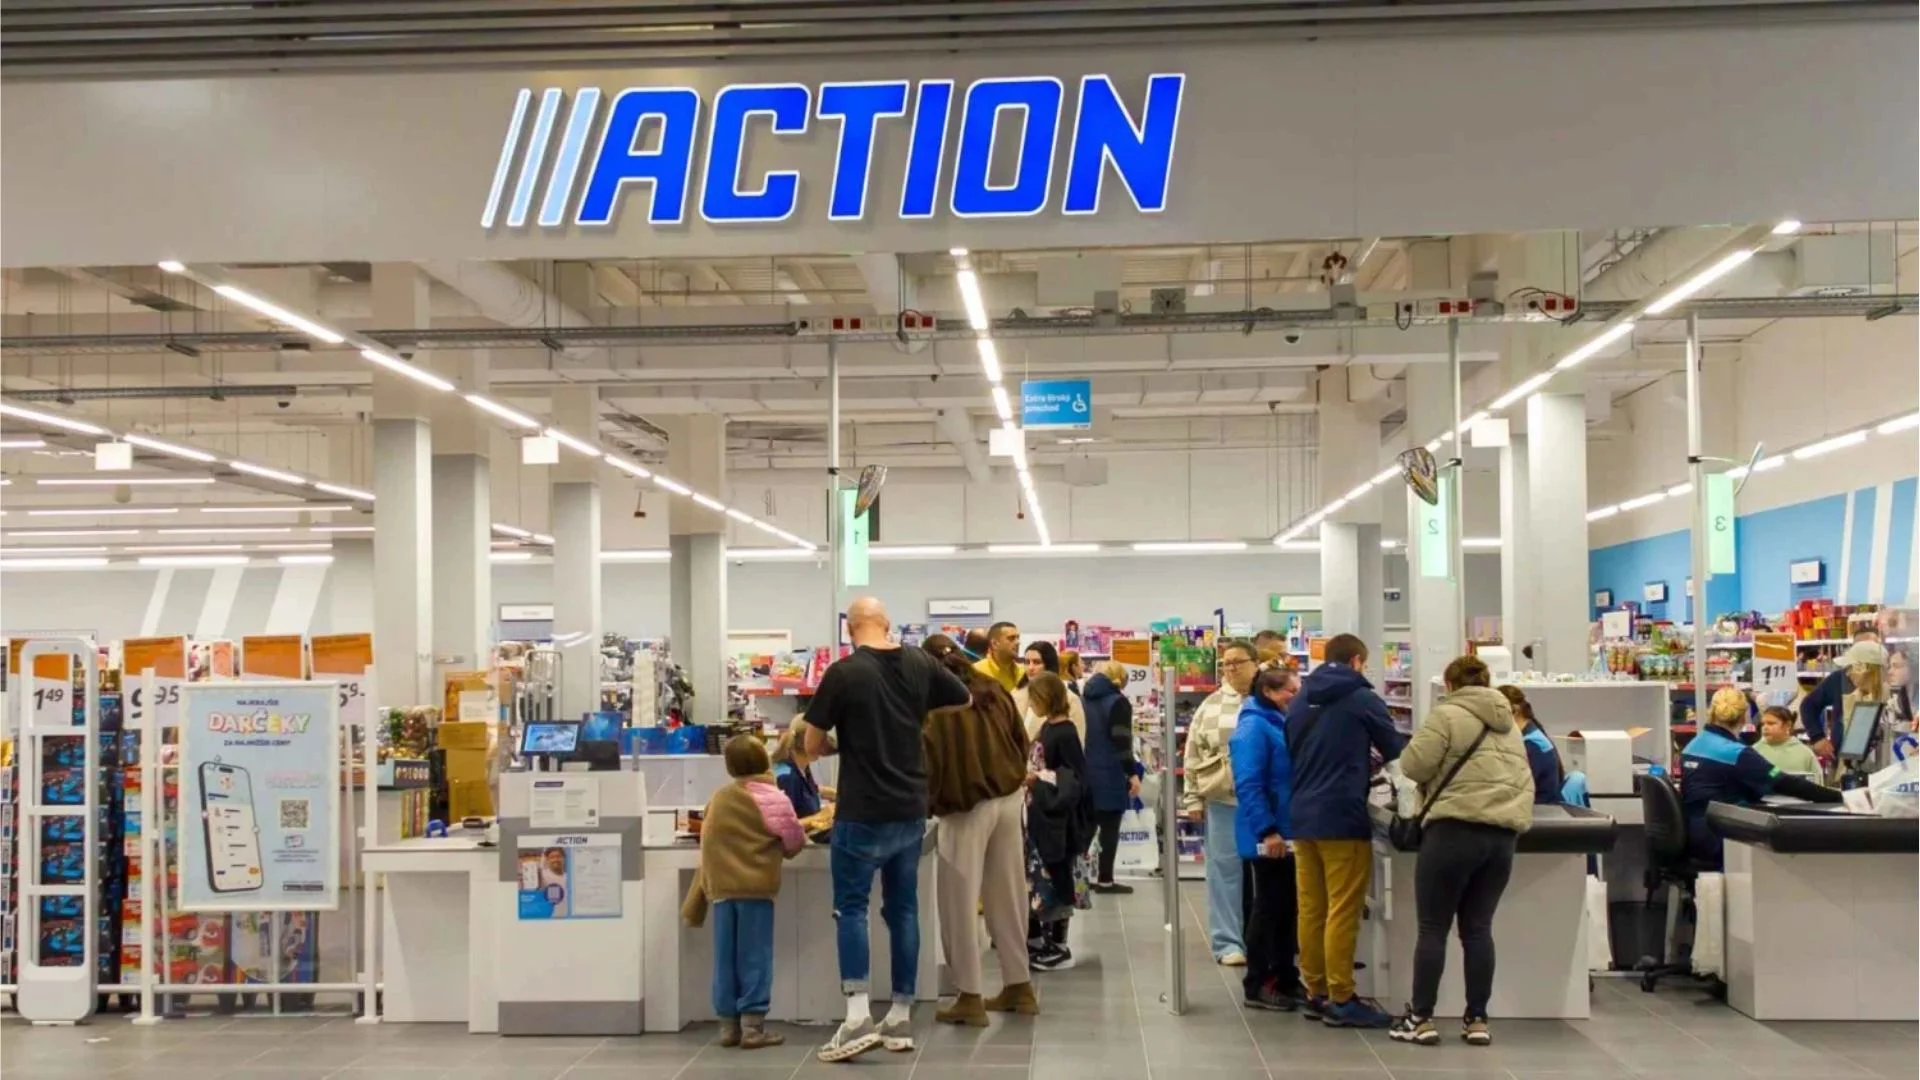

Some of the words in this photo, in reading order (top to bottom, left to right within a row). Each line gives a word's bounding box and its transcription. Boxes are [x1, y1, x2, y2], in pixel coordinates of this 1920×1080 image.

[574, 73, 1186, 226] ACTION
[207, 707, 311, 735] DARČEKY
[556, 836, 588, 845] ACTION
